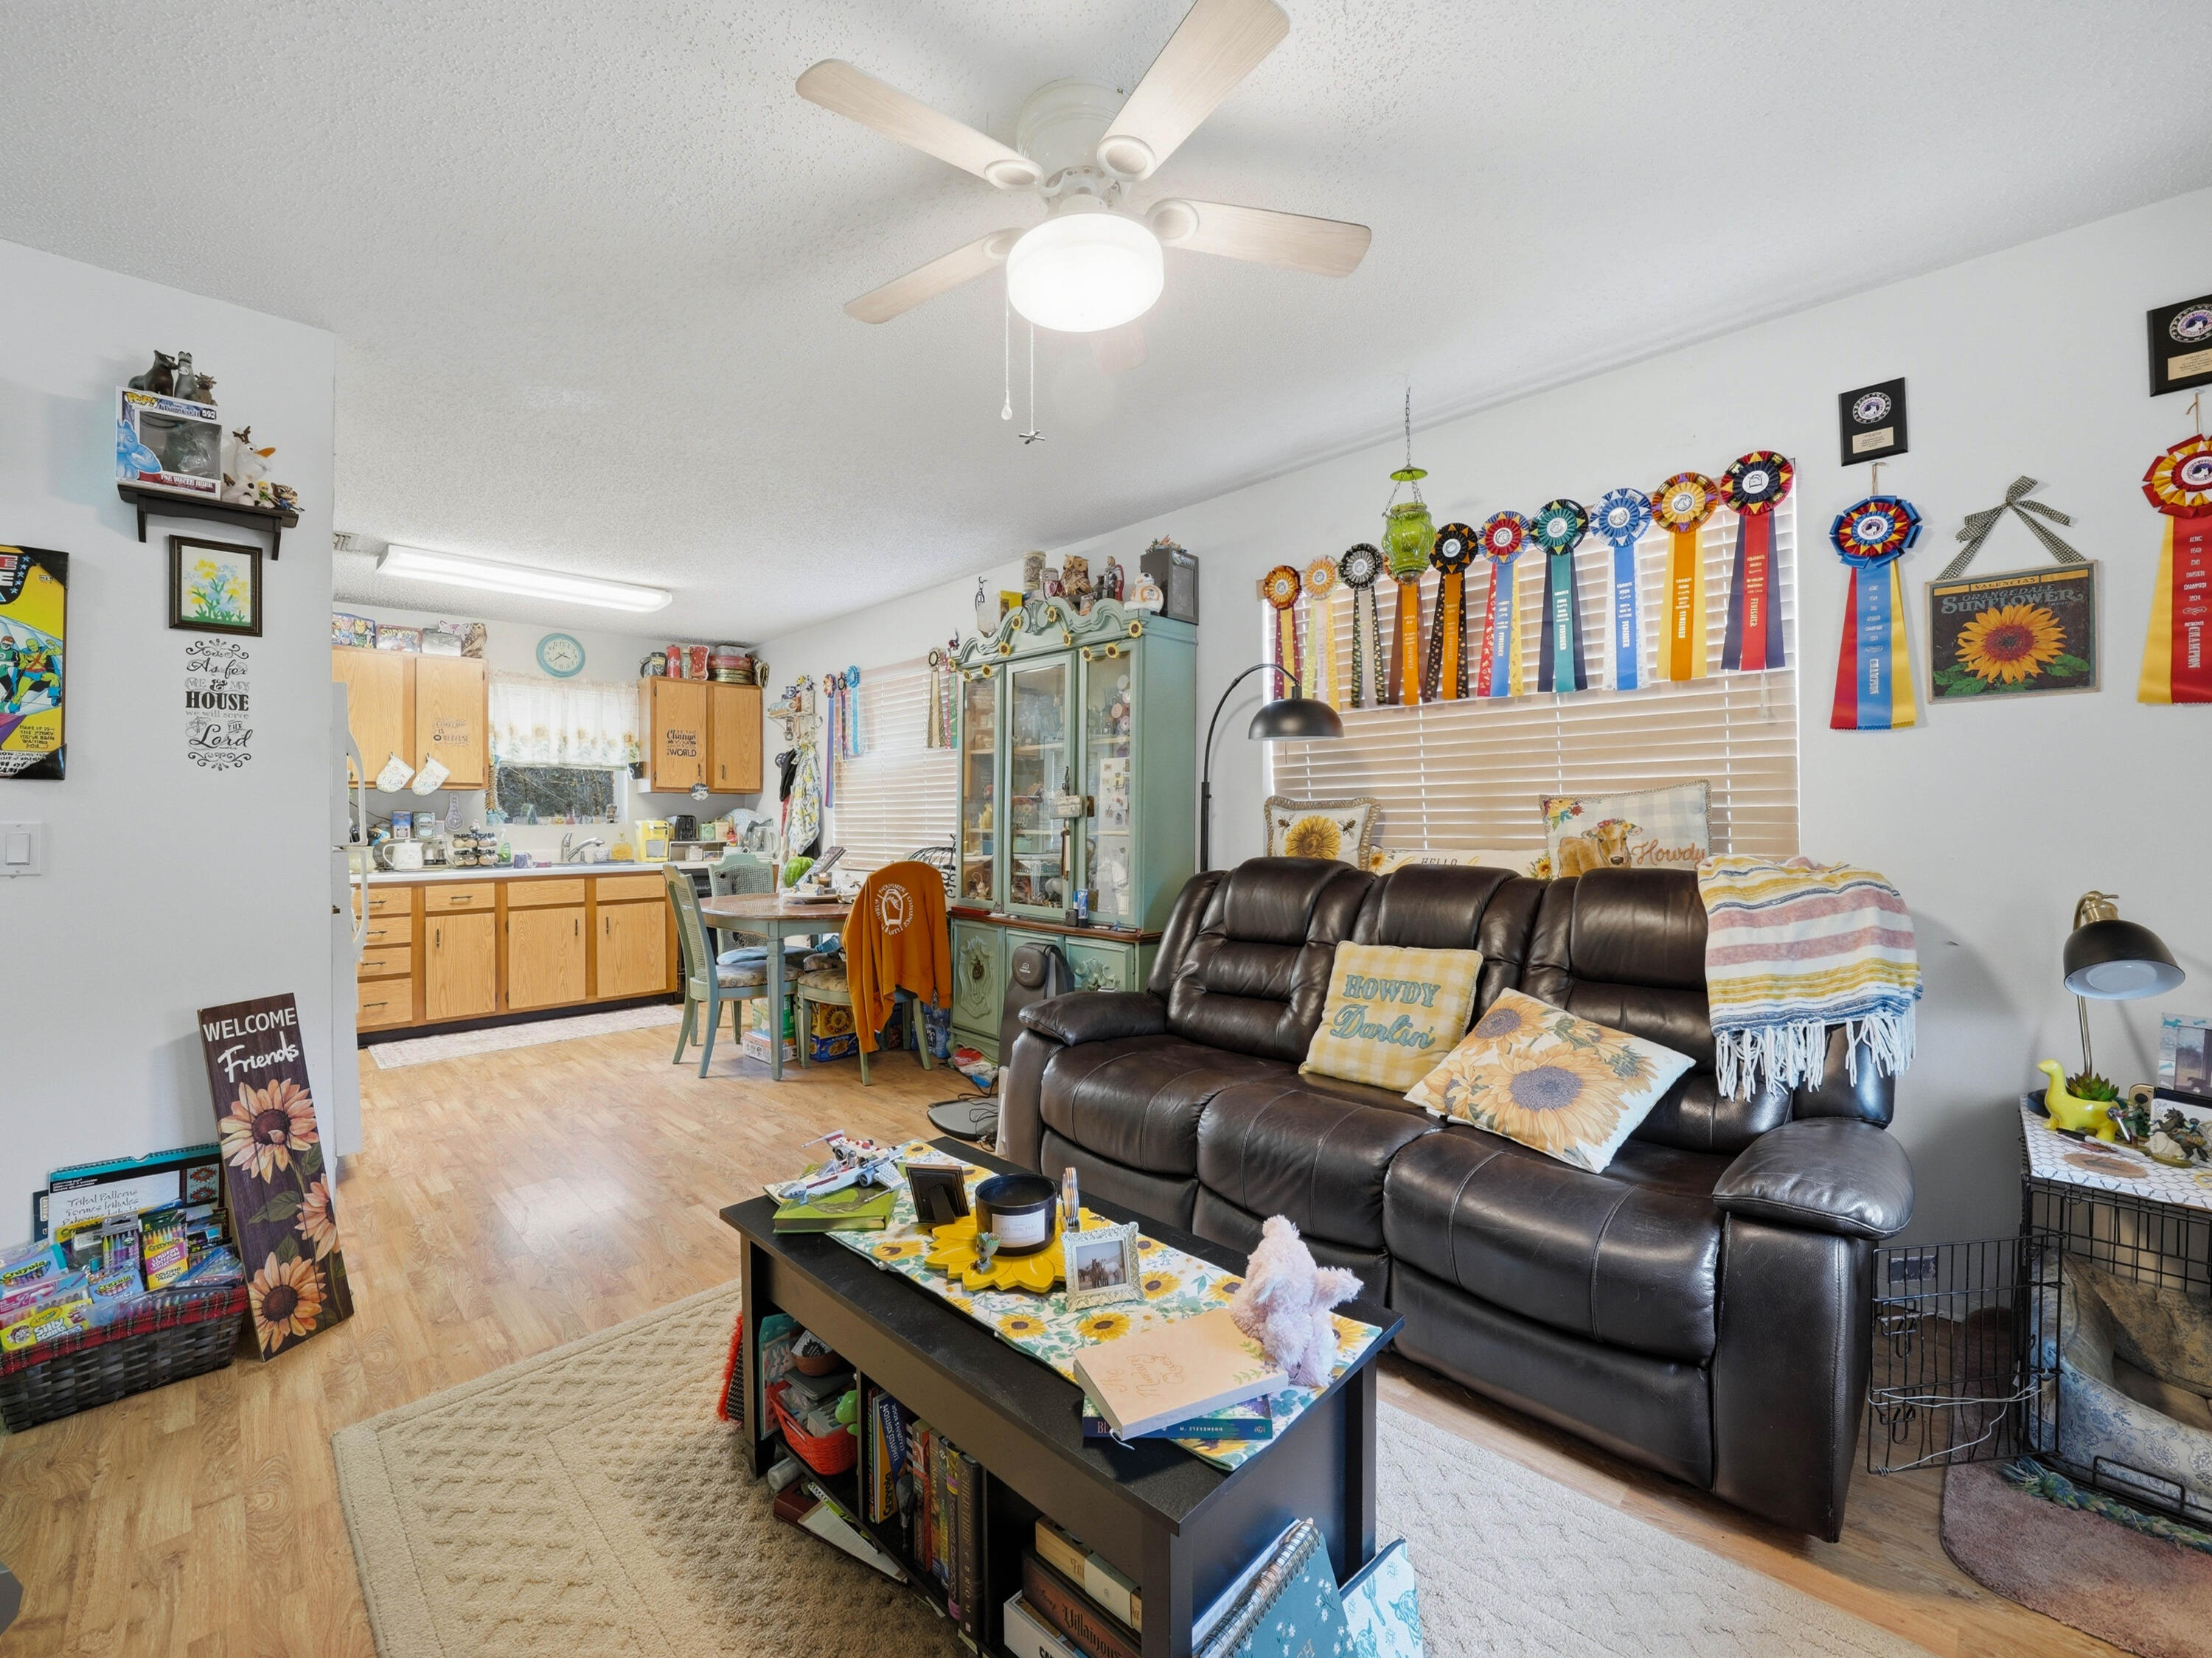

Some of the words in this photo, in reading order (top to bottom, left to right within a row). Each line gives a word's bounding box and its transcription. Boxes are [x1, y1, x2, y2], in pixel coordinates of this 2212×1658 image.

[1941, 588, 2084, 614] SUNFLOWER
[1962, 583, 2056, 602] ORANGEDALE
[2188, 627, 2201, 669] CHAMPION
[187, 658, 218, 675] As
[225, 659, 247, 679] for
[209, 678, 228, 692] &
[185, 691, 249, 711] HOUSE
[188, 723, 253, 749] Lord
[1421, 857, 1458, 865] HELLO
[1632, 840, 1705, 870] Howdy
[1343, 975, 1441, 1008] HOWDY
[203, 1007, 296, 1042] WELCOME
[1330, 1004, 1436, 1050] Darlin'
[218, 1031, 299, 1083] Friends
[2, 1259, 47, 1281] Crayola
[883, 1474, 892, 1516] Crayola
